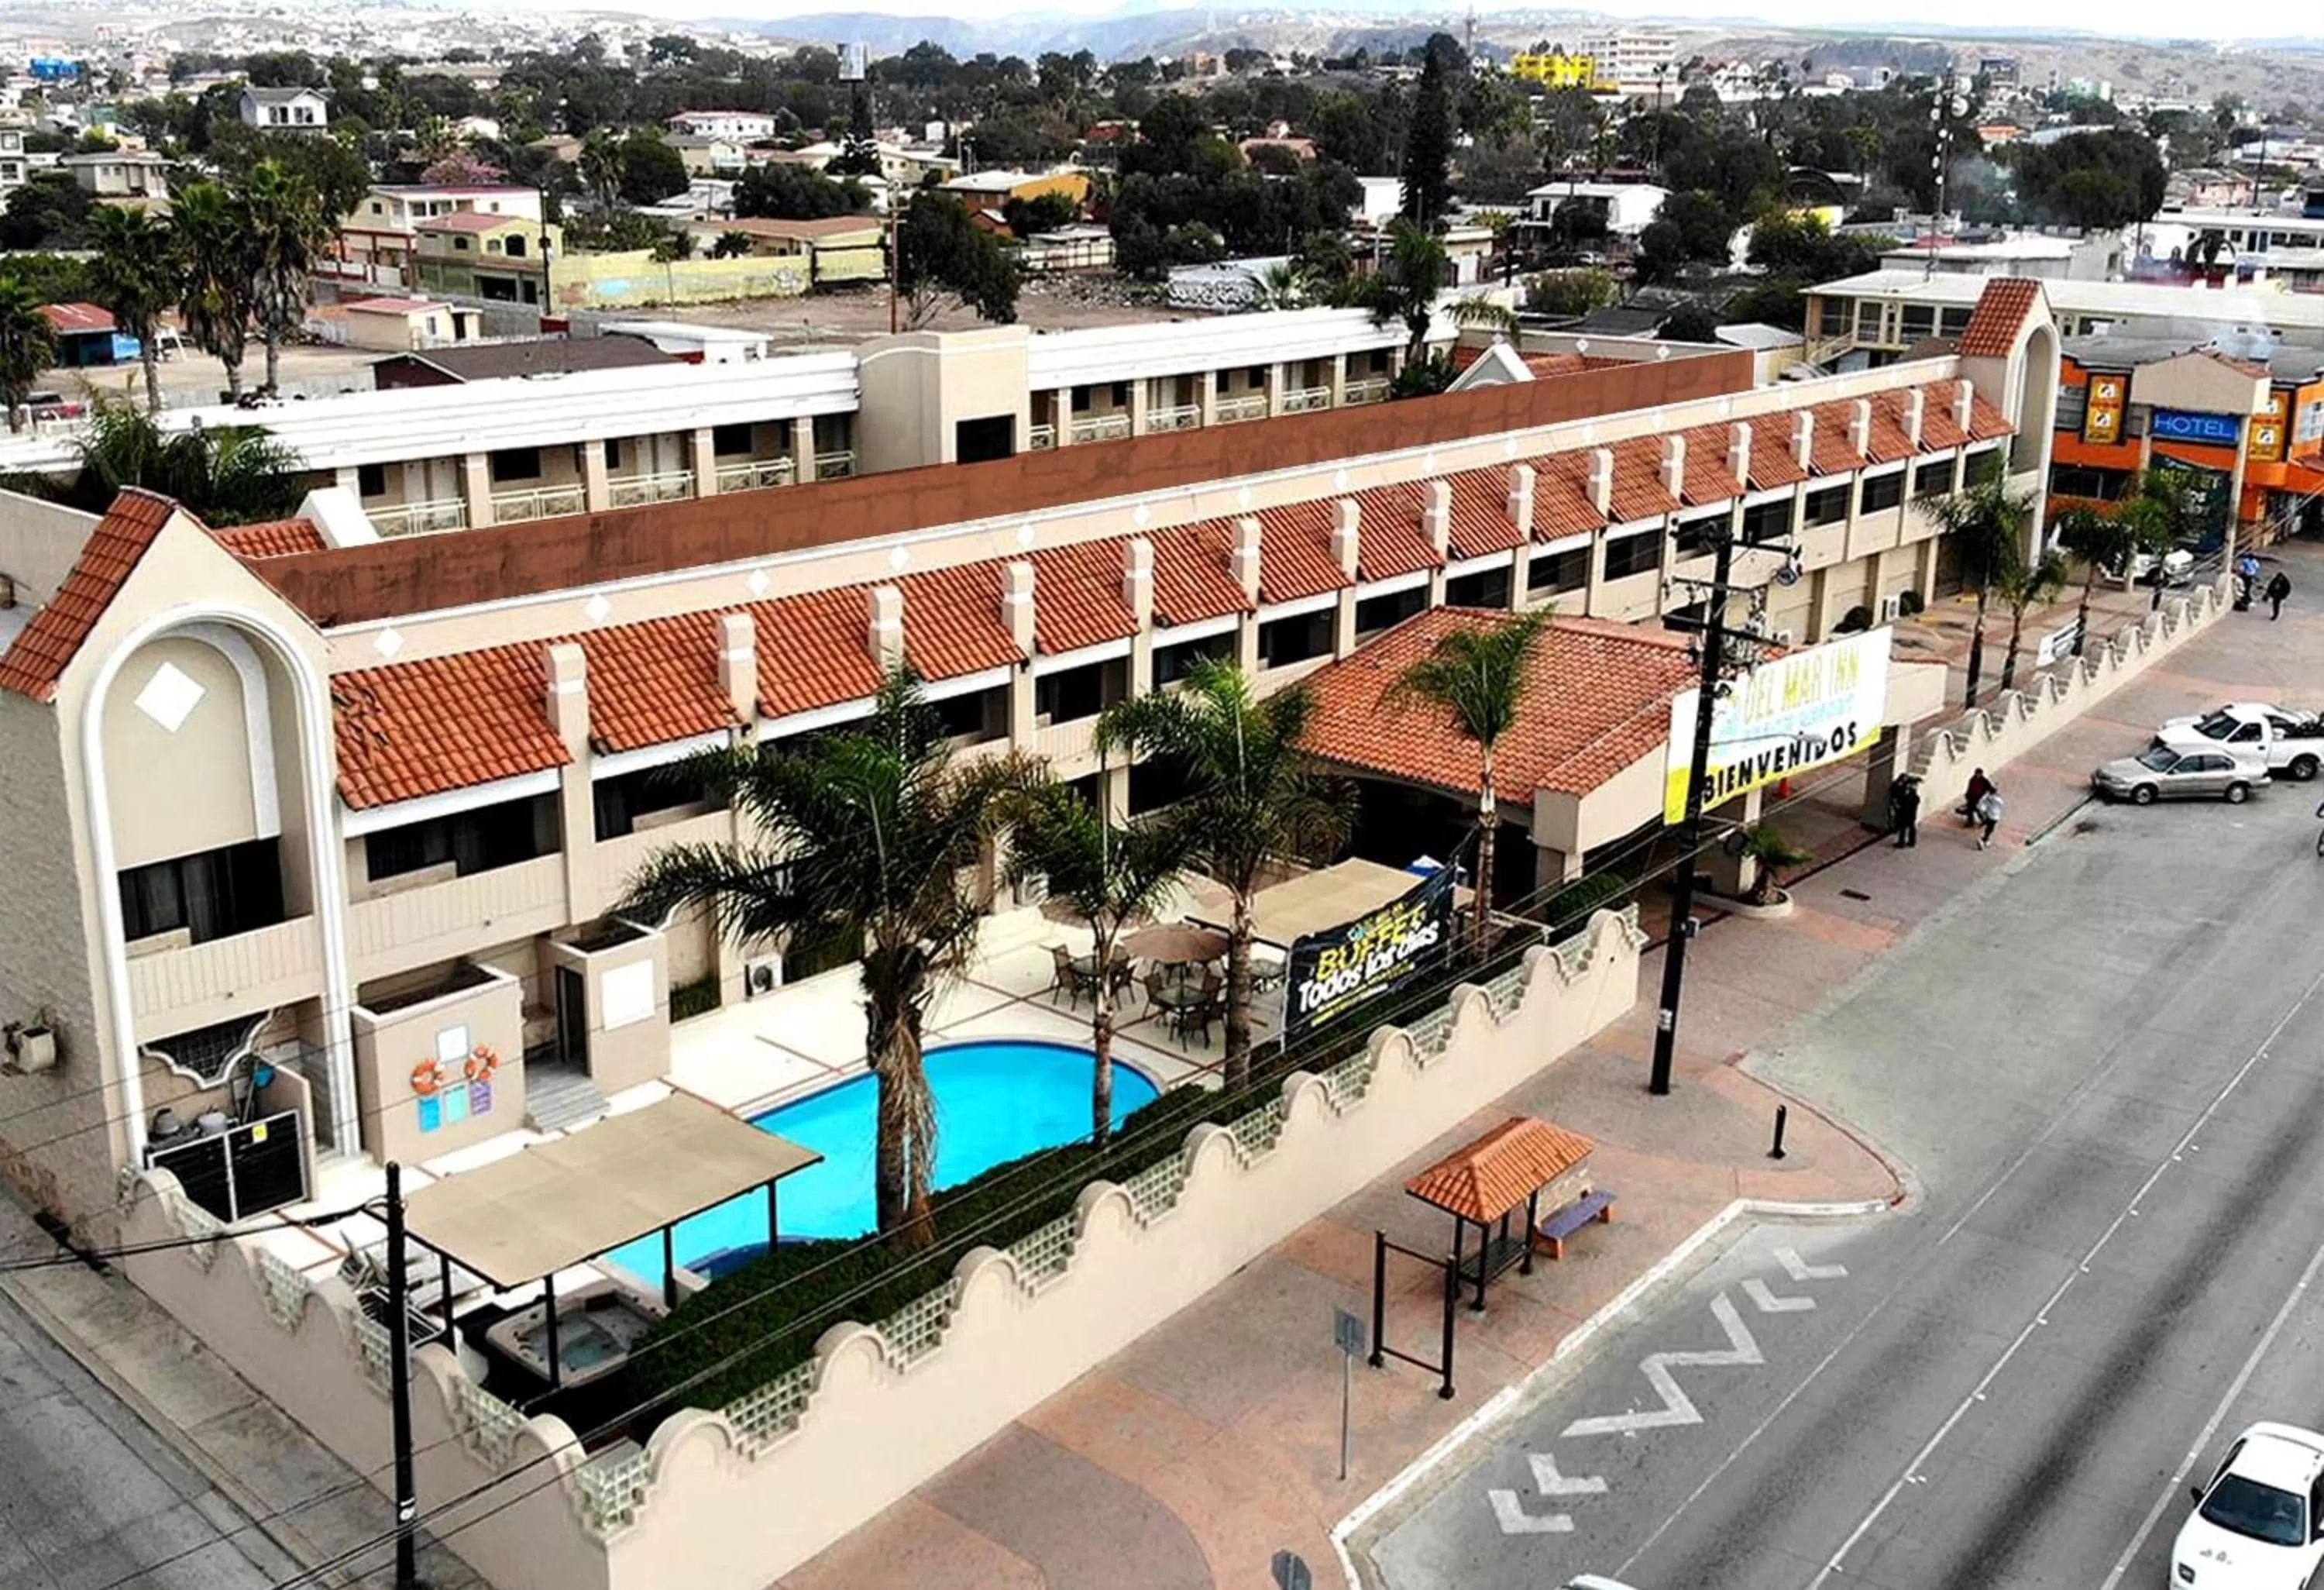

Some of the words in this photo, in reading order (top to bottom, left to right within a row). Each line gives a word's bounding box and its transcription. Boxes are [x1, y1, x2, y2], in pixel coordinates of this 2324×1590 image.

[2154, 415, 2232, 438] HOTEL
[1744, 668, 1776, 726] DEL
[1781, 654, 1823, 713] MAR
[1829, 644, 1861, 697] INN
[1703, 721, 1858, 805] BIENVENIDOS
[1316, 901, 1428, 982] BUFFET
[1298, 965, 1363, 1013] Todos
